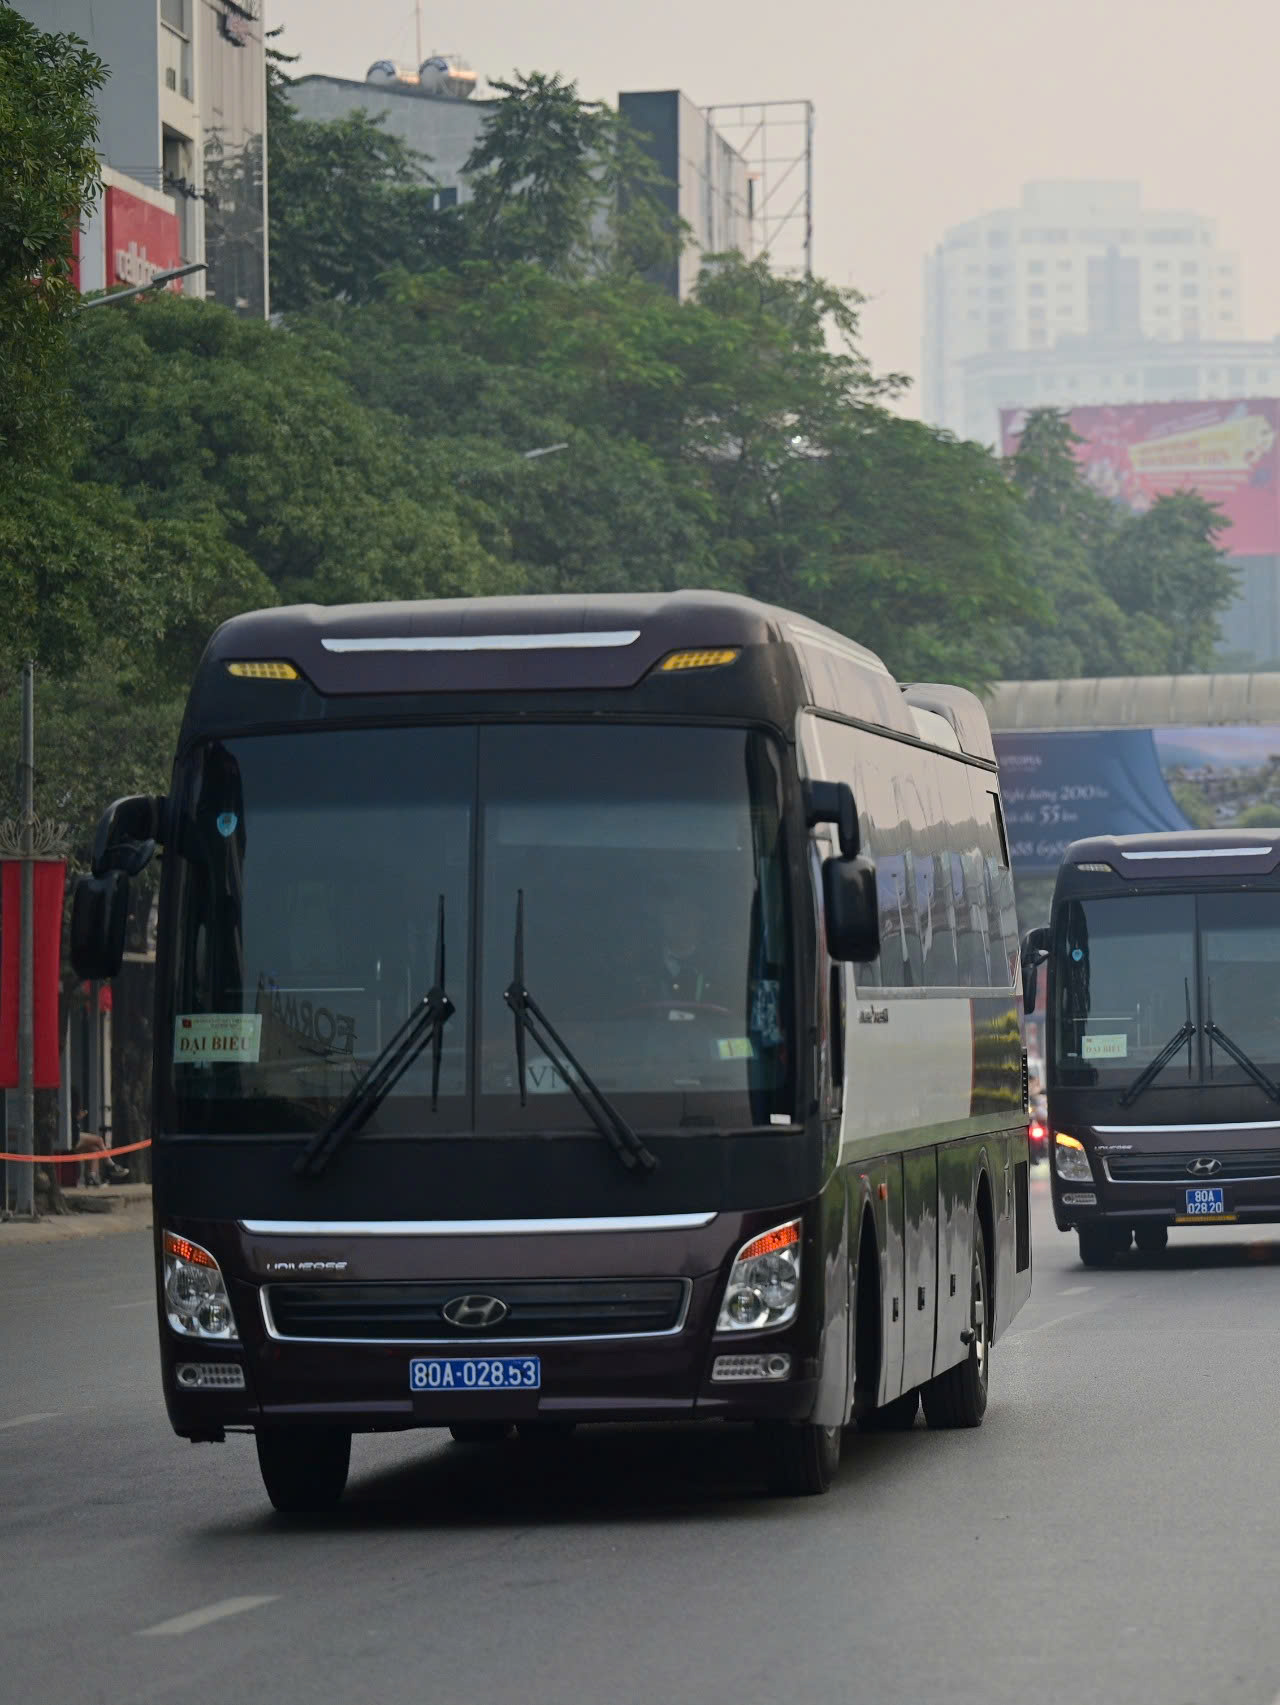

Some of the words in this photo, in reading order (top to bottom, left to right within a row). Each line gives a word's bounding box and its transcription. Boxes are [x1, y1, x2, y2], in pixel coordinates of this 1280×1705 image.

[1060, 784, 1094, 801] 200
[1039, 803, 1061, 825] 55
[1194, 1190, 1215, 1203] 80A
[1187, 1202, 1222, 1214] 028.20
[413, 1360, 537, 1387] 80A-028.53
